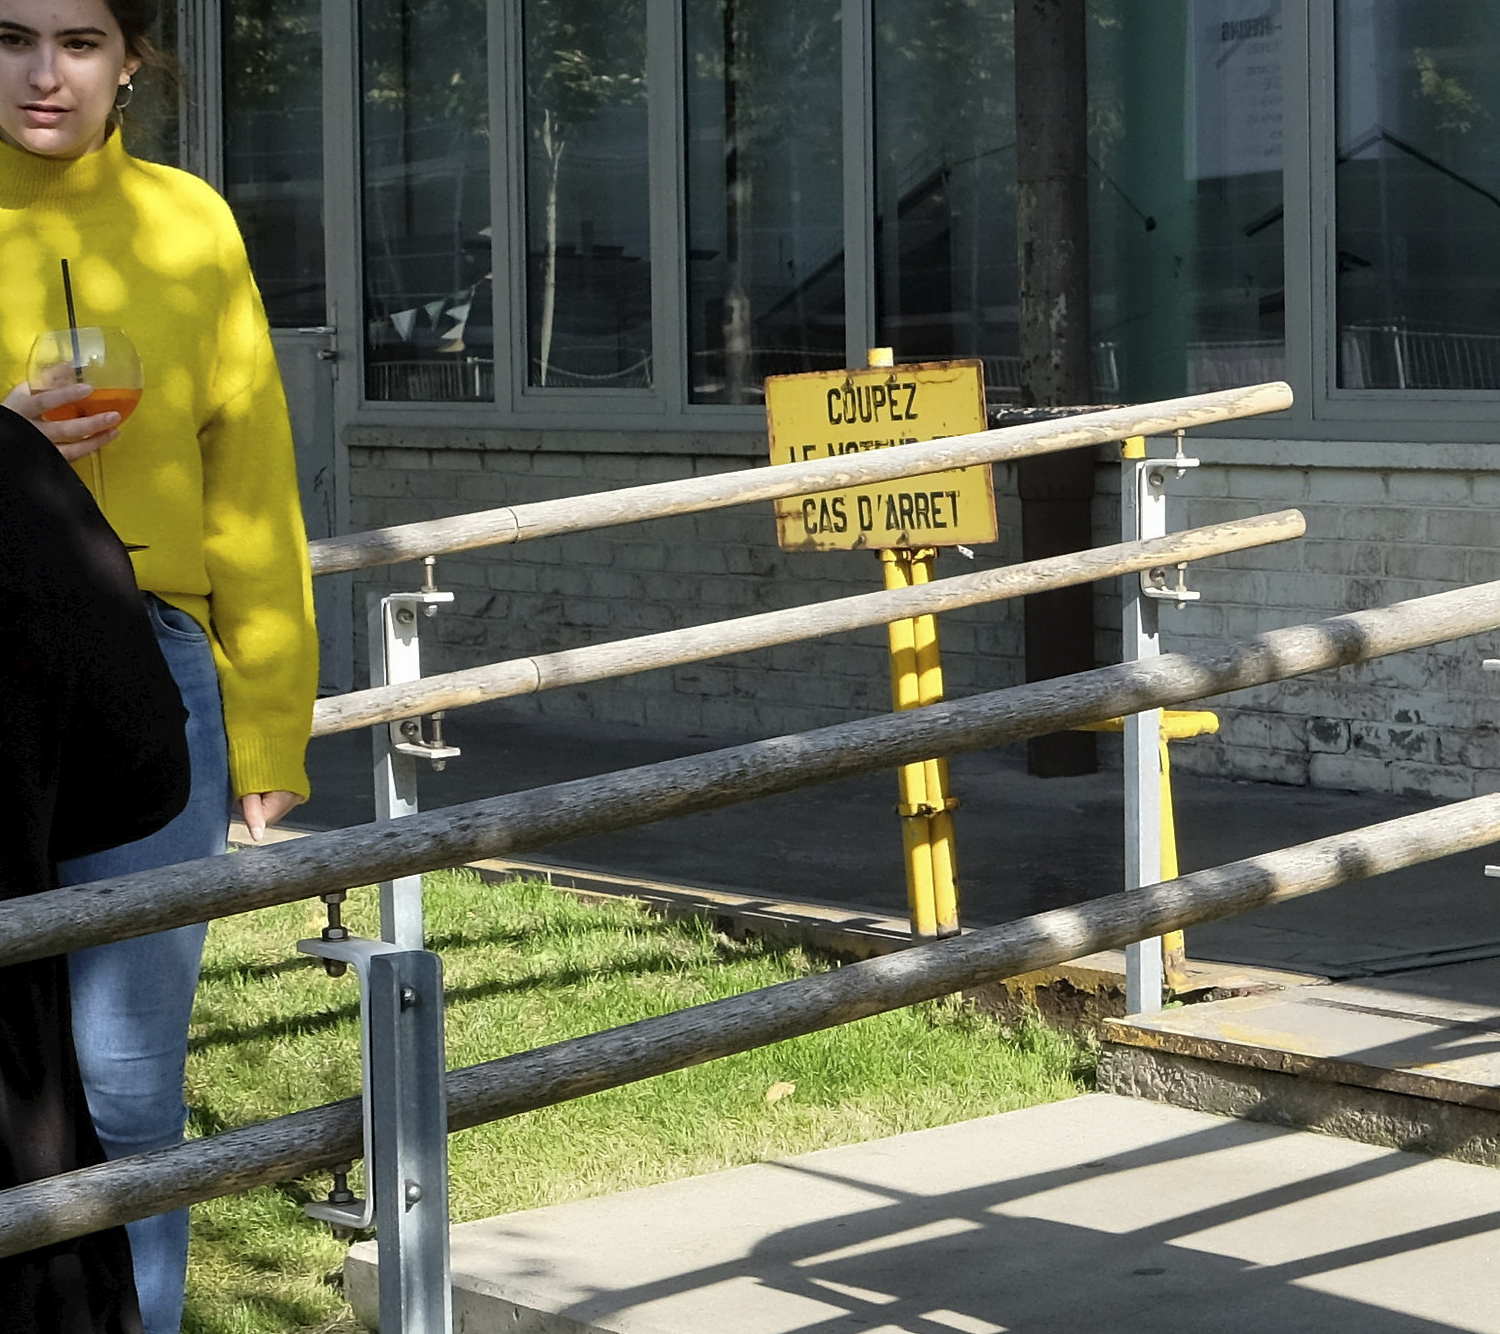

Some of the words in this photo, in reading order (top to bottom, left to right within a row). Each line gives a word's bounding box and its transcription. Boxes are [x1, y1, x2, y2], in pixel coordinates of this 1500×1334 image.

[826, 381, 919, 425] COUPEZ
[801, 496, 848, 534] CAS
[857, 490, 961, 532] D'ARRET
